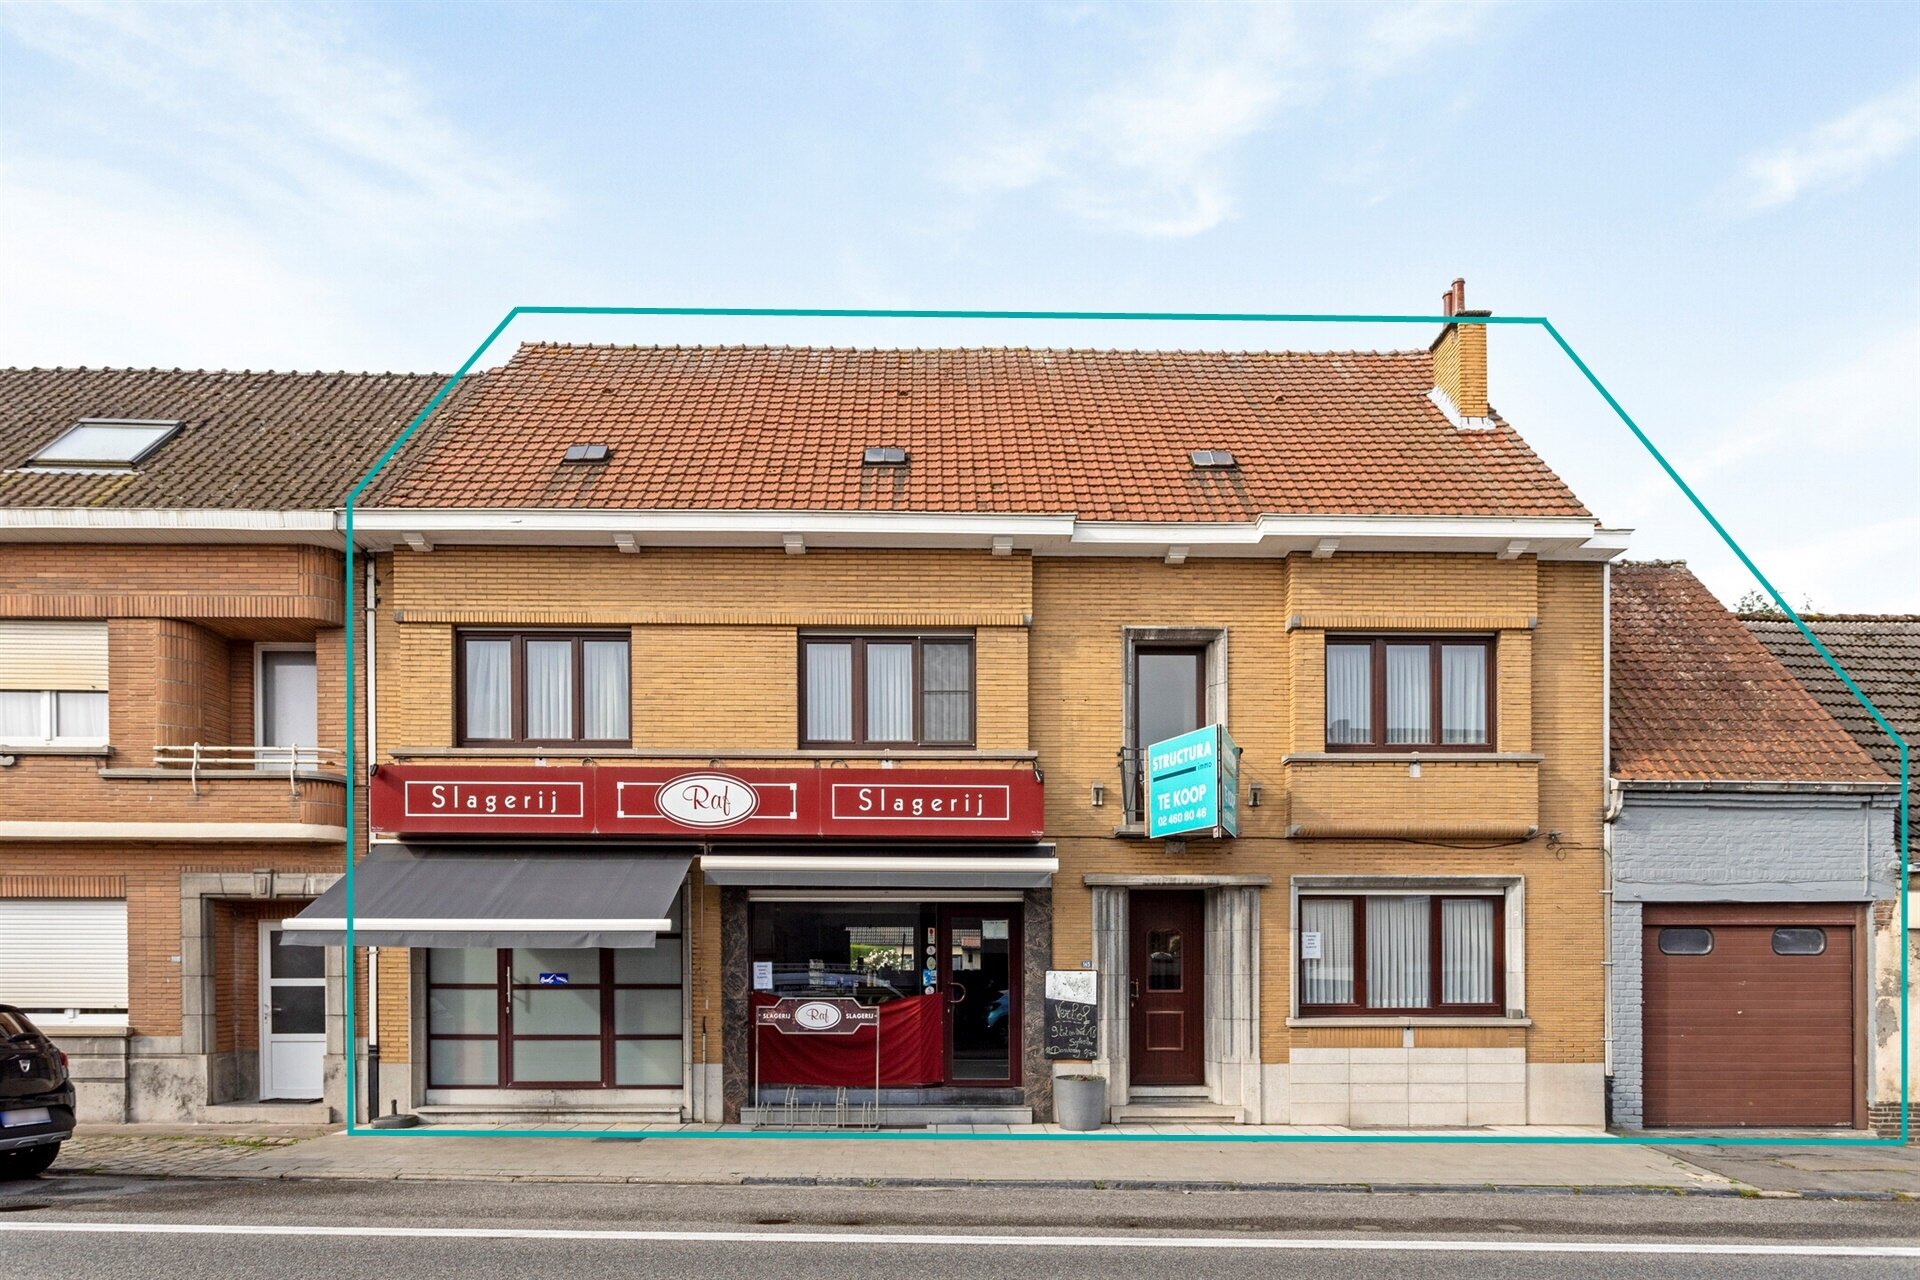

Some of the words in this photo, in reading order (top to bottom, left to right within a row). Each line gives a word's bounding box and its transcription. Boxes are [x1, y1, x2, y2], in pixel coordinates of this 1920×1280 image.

[1152, 741, 1212, 771] STRUCTURA
[1198, 762, 1212, 771] immo
[431, 785, 557, 814] Slagerij
[682, 785, 731, 817] Raf
[858, 788, 983, 816] Slagerij
[1158, 793, 1170, 811] TE
[1173, 784, 1207, 808] KOOP
[1158, 816, 1168, 827] 02
[1184, 809, 1195, 822] 80
[762, 1012, 791, 1020] SLAGERIJ
[806, 1008, 830, 1024] Raf
[845, 1012, 874, 1020] SLAGERIJ
